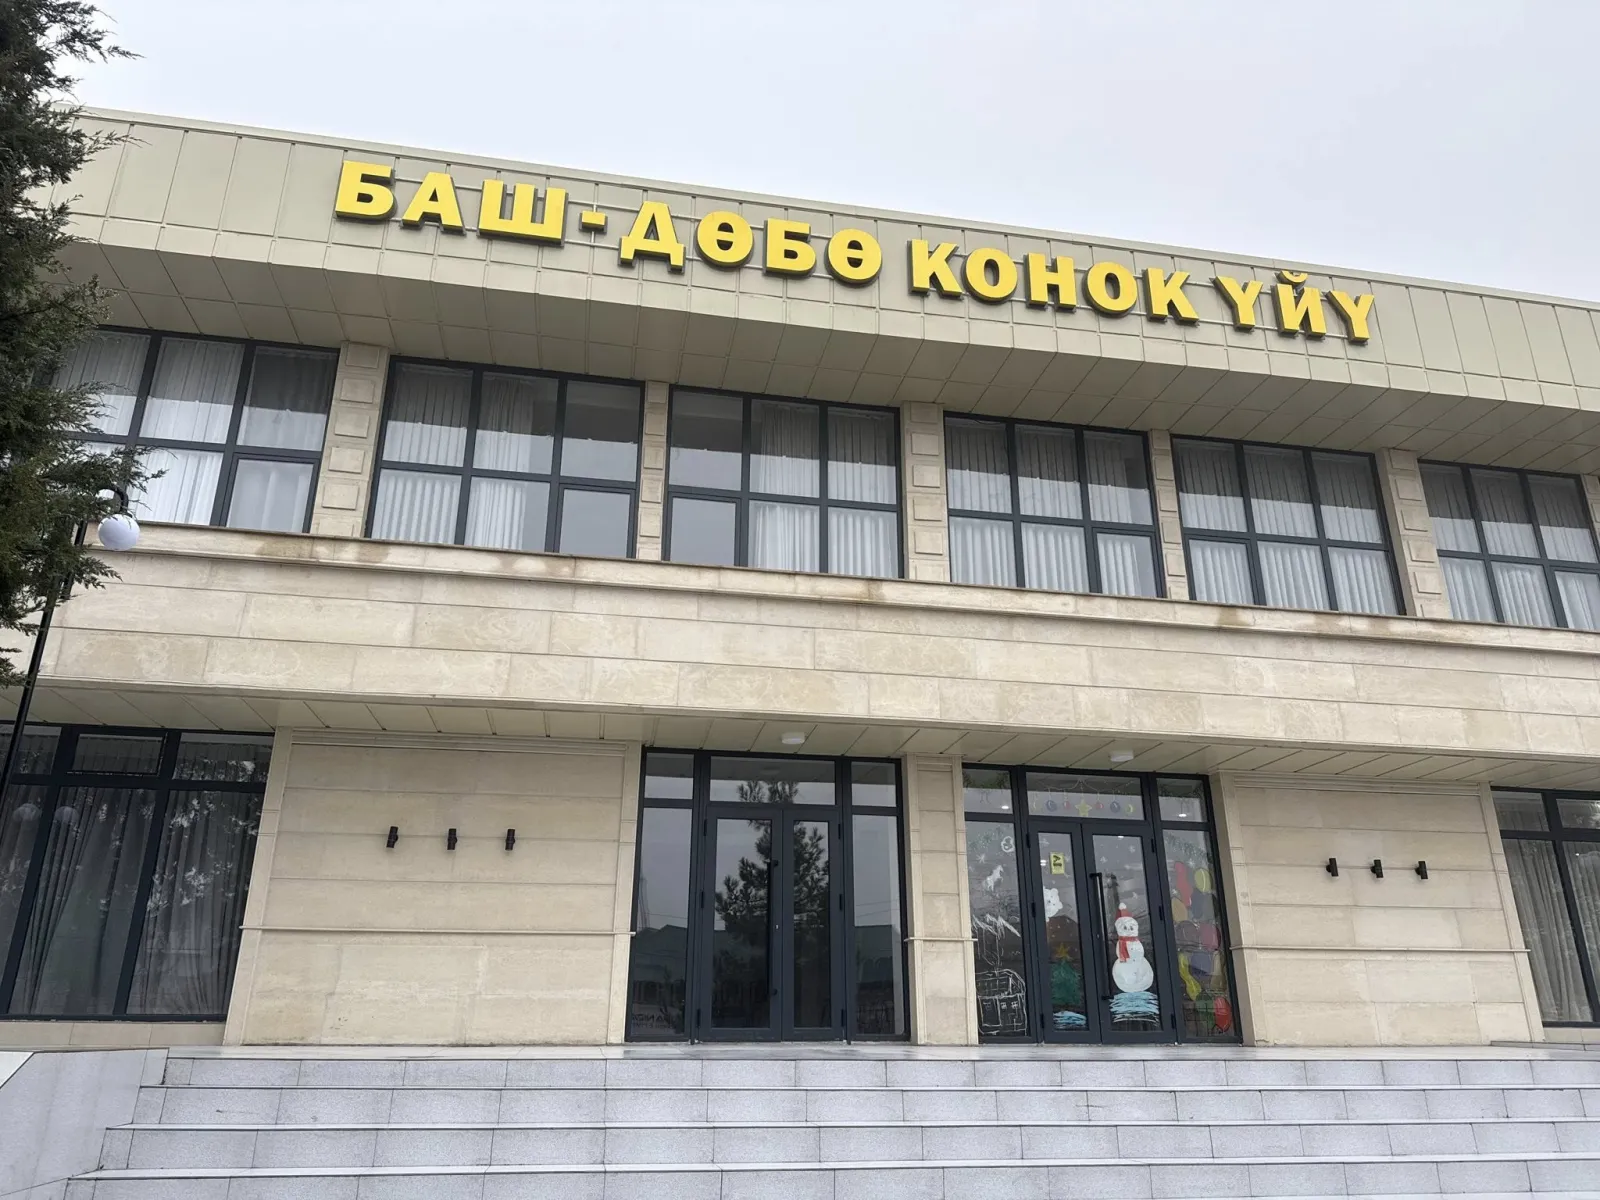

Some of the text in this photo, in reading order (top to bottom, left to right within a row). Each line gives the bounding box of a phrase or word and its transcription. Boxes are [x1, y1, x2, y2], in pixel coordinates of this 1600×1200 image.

[335, 159, 1374, 343] БАШ-ДӨБӨ КОНОК ҮЙҮ
